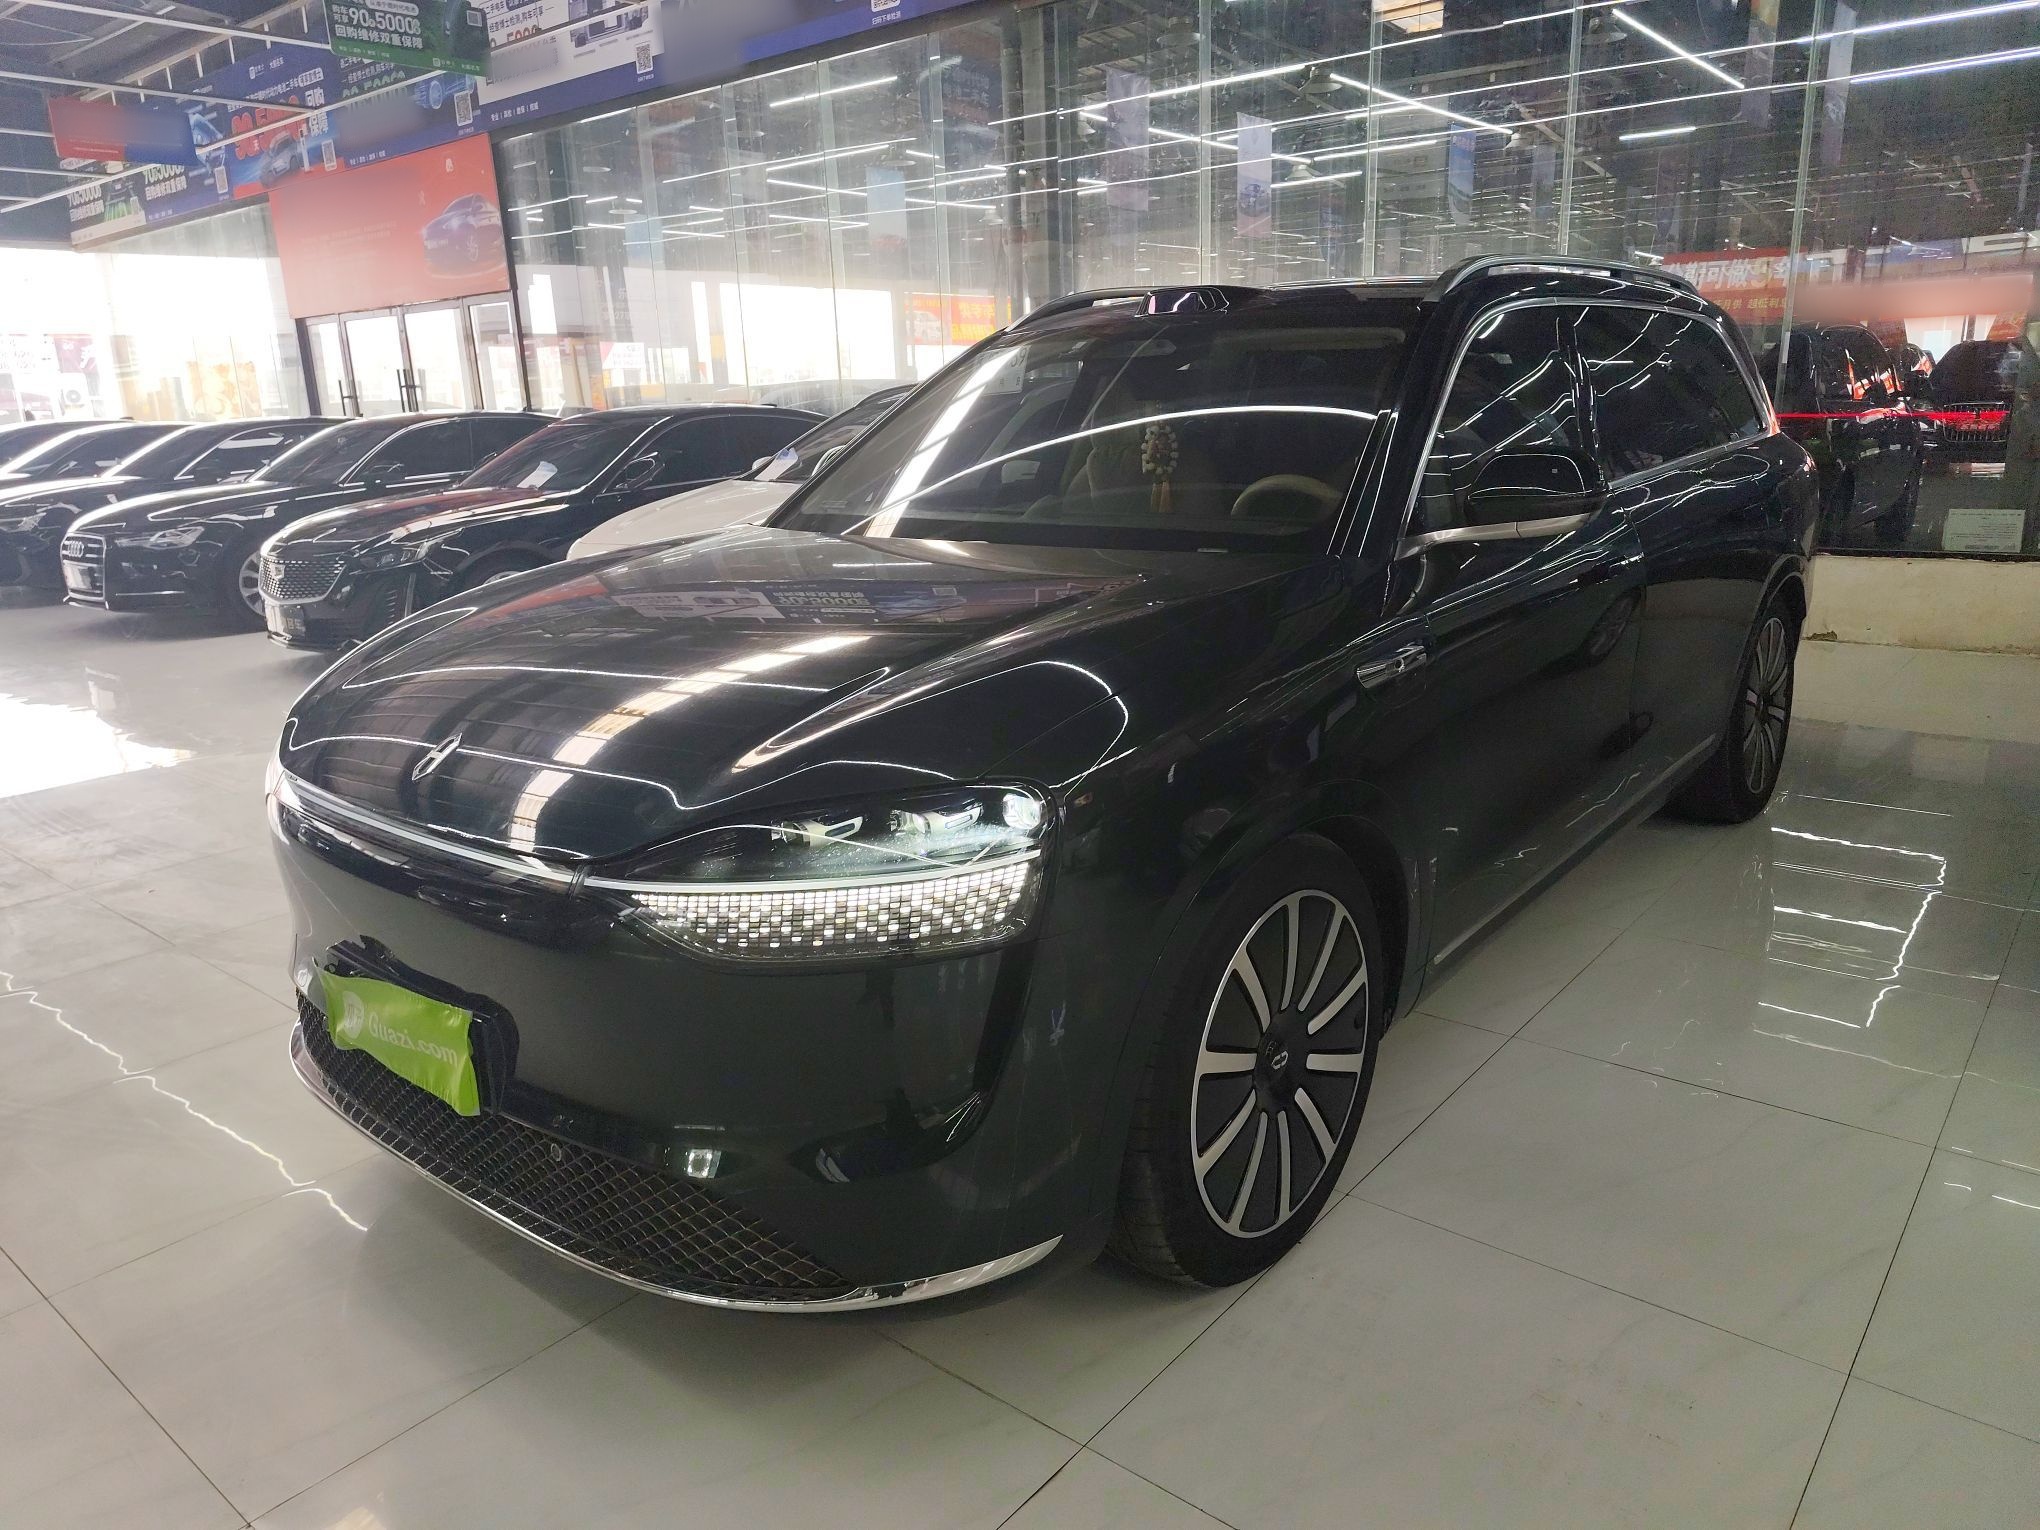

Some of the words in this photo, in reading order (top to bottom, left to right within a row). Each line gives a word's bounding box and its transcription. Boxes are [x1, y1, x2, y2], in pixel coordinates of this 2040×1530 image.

[335, 24, 424, 49] 回购维修双重保障
[369, 1011, 458, 1067] Guazi.com
